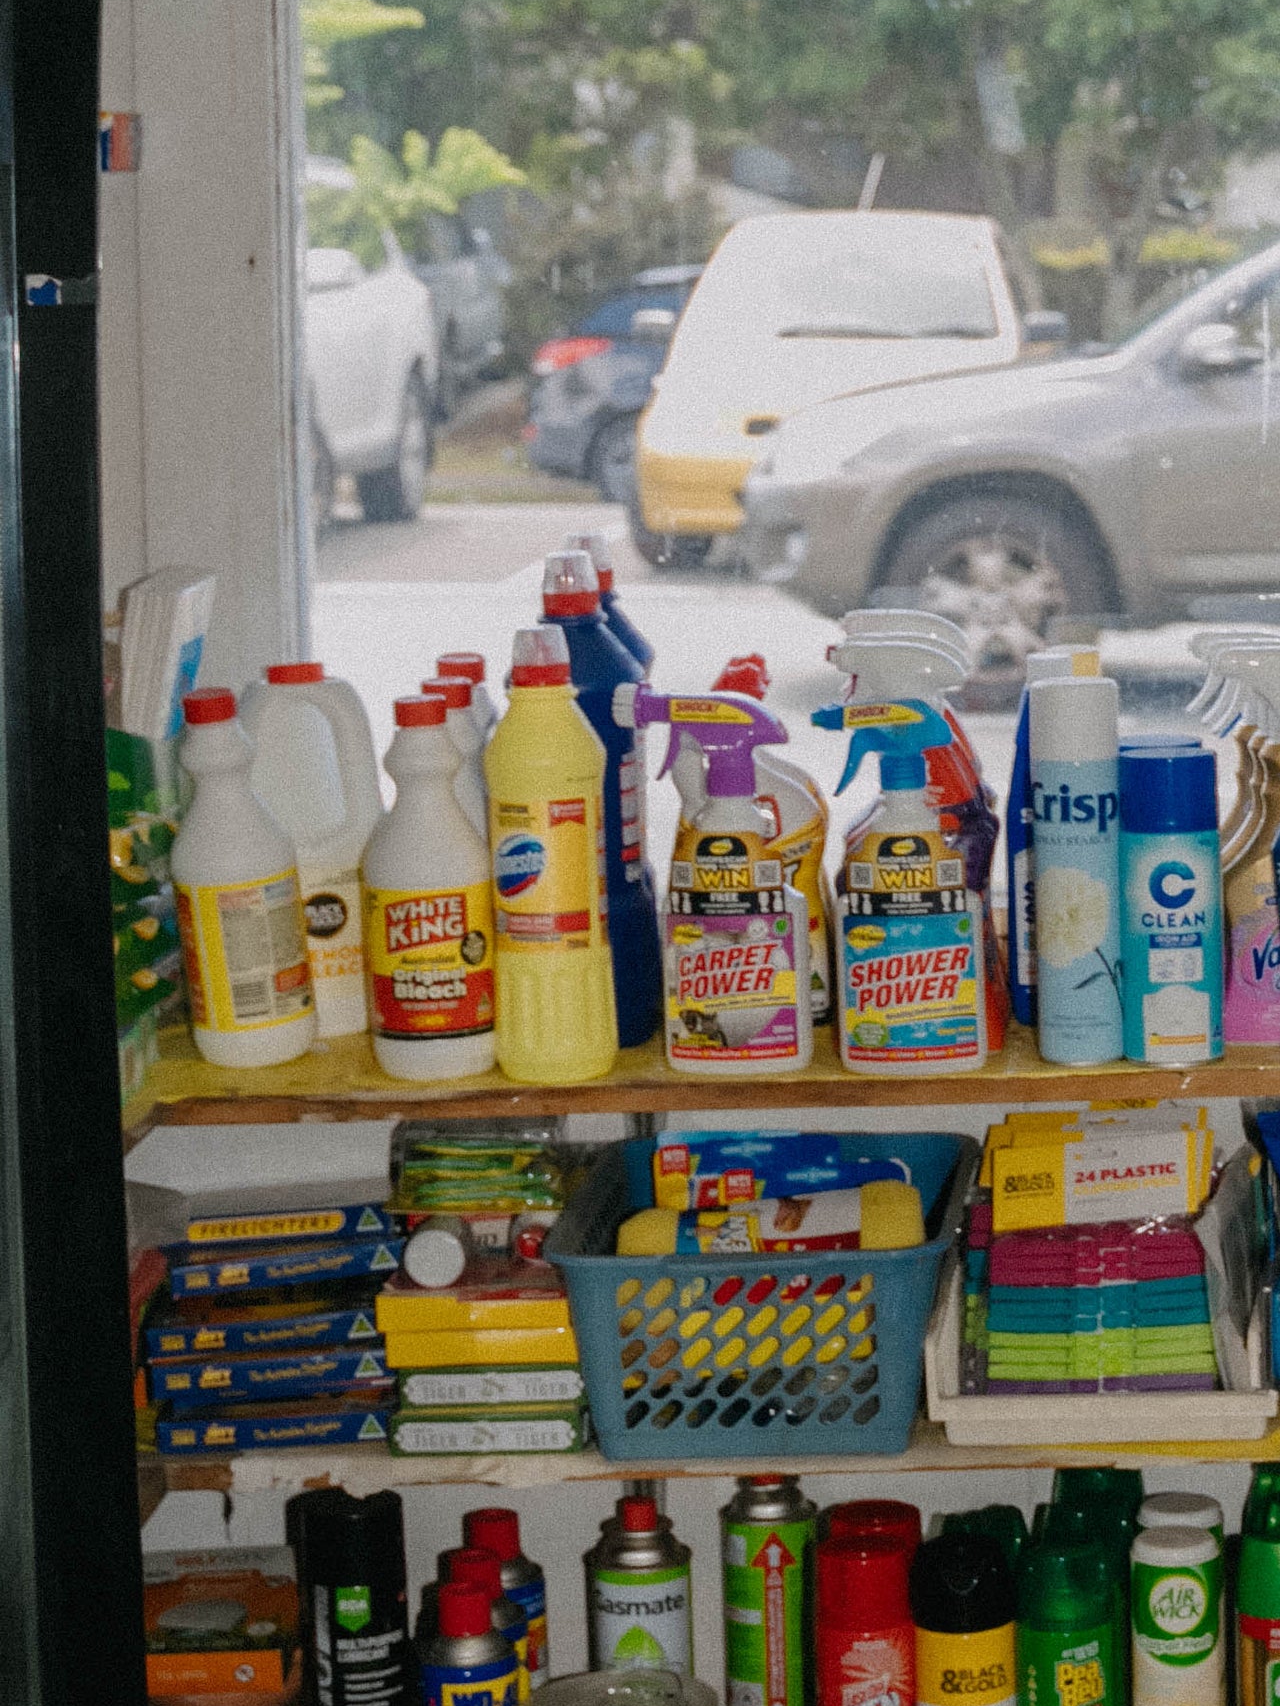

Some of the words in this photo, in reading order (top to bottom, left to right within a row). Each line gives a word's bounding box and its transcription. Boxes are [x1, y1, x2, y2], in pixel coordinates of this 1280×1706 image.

[697, 867, 749, 890] WIN
[879, 867, 933, 890] WIN
[1141, 911, 1207, 931] CLEAN
[678, 942, 779, 979] CARPET
[849, 945, 971, 989] SHOWER
[393, 965, 467, 986] Original
[679, 967, 778, 1001] POWER
[393, 980, 468, 1001] Bleach
[858, 973, 960, 1013] POWER
[1074, 1170, 1096, 1184] 24
[1099, 1161, 1177, 1181] PLASTIC
[940, 1668, 958, 1695] &
[956, 1664, 1006, 1681] BLACK
[956, 1675, 1008, 1693] GOLD
